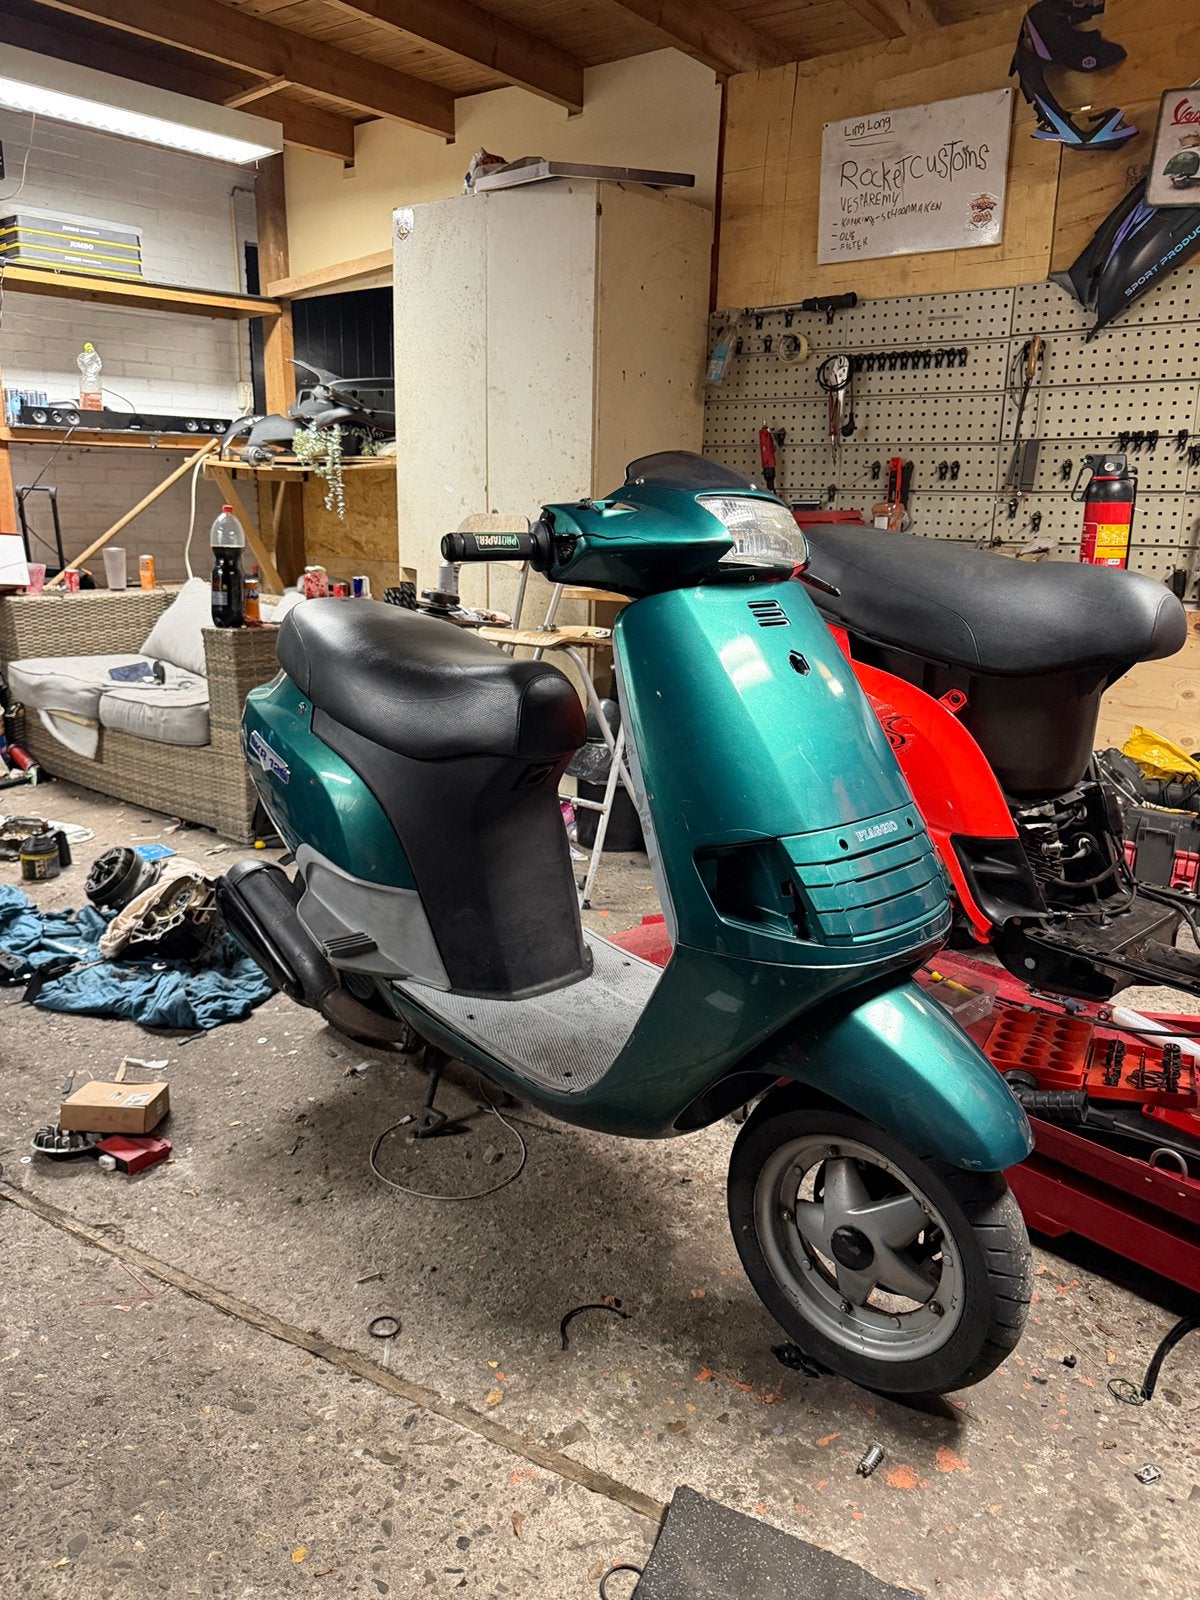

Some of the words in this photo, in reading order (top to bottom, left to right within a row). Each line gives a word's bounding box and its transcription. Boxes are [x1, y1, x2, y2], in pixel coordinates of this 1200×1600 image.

[69, 241, 94, 251] JUMBO
[1124, 264, 1159, 297] SPORT
[479, 535, 518, 546] PROTAPER
[855, 820, 899, 842] PIAGGIO
